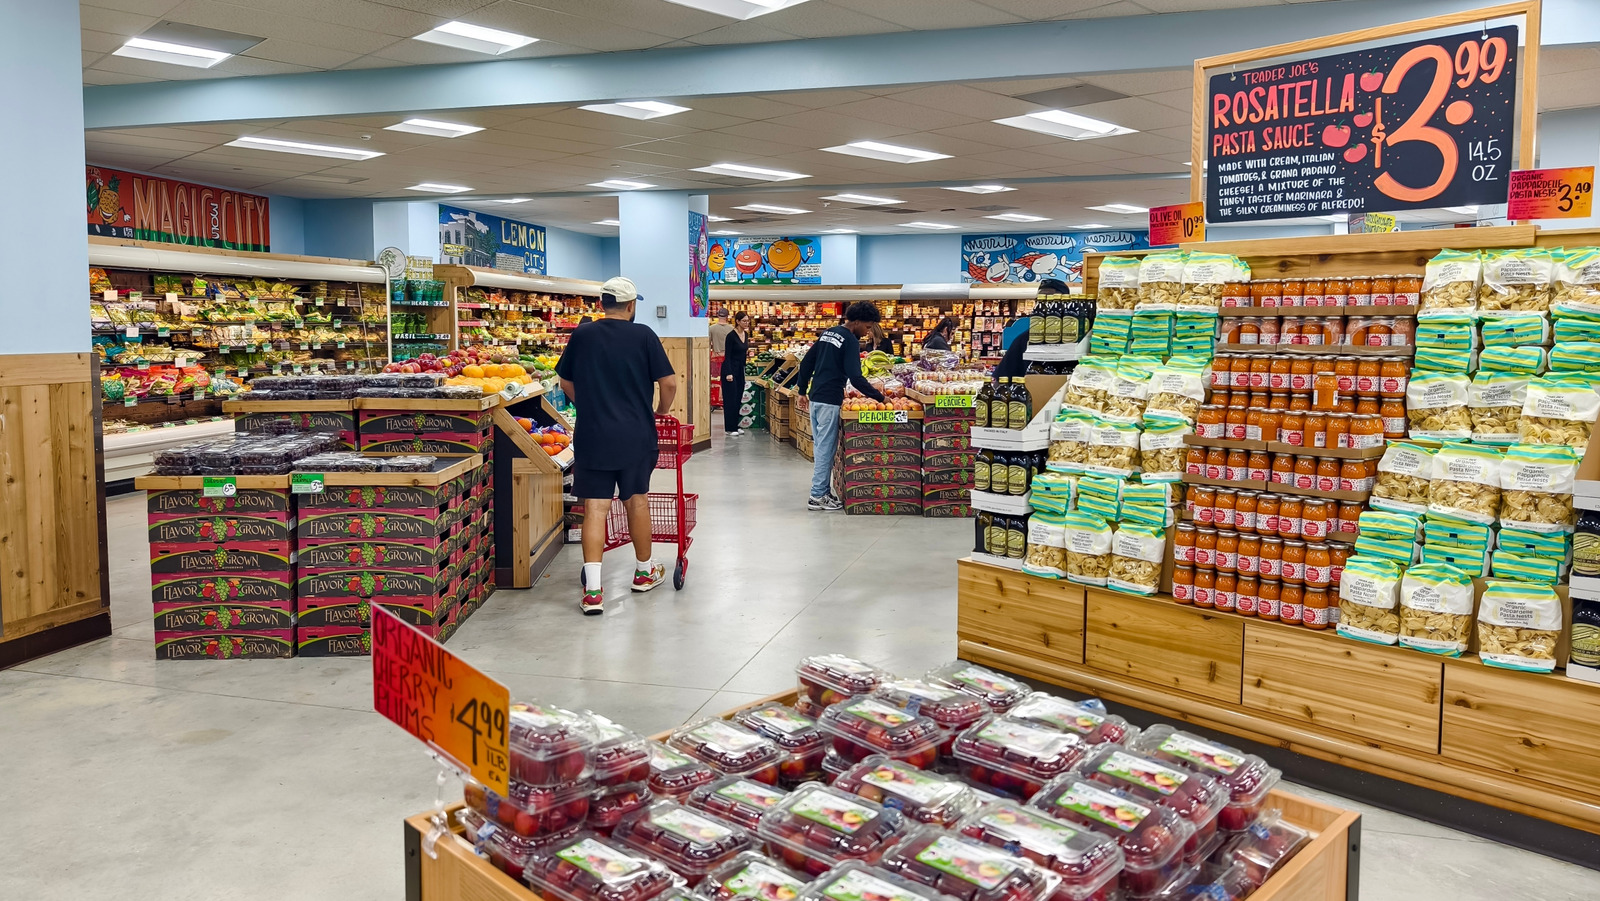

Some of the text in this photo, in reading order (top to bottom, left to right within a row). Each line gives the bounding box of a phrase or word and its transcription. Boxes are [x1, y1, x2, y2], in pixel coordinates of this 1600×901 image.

[1242, 62, 1319, 86] TRADER JOE'S
[1213, 72, 1355, 129] ROSATELLA
[1213, 122, 1315, 157] PASTA SAUCE
[1468, 139, 1502, 161] 14.5
[1218, 152, 1334, 172] MADE WITH CREAM, ITALIAN
[1270, 169, 1298, 180] GRANA
[1301, 165, 1336, 176] PADANO
[1472, 164, 1498, 181] OZ
[1218, 176, 1346, 197] CHEESE! A MIXTURE OF THE
[1510, 189, 1557, 199] PASTA NESTS
[1219, 188, 1343, 206] TANGY TASTE OF MARINARA &
[132, 176, 268, 252] MAGIC CITY
[1219, 198, 1365, 217] THE SILKY CREAMINESS OF ALFREDO!
[1150, 210, 1182, 222] OLIVE OIL
[501, 220, 545, 252] LEMON
[964, 234, 1017, 261] merrily
[1024, 235, 1077, 254] merrily
[1084, 232, 1140, 253] merrily
[524, 251, 544, 270] CITY
[938, 398, 966, 407] PEACHES
[311, 417, 344, 428] GROWN
[386, 418, 453, 429] FLAVOR GROWN
[860, 412, 894, 421] PEACHES
[422, 444, 450, 452] GROWN
[160, 495, 275, 510] FLAVOR GROWN
[310, 491, 423, 505] FLAVOR GROWN
[160, 524, 276, 540] FLAVOR GROWN
[310, 521, 423, 535] FLAVOR GROWN
[181, 555, 260, 570] FLAVOR GROWN
[310, 550, 423, 564] FLAVOR GROWN
[163, 585, 277, 600] FLAVOR GROWN
[310, 578, 422, 593] FLAVOR GROWN
[165, 613, 280, 628] FLAVOR GROWN
[325, 608, 356, 622] FLAVOR
[167, 642, 280, 658] FLAVOR GROWN
[328, 639, 360, 653] FLAVOR
[374, 610, 454, 690] ORGANIC
[374, 649, 438, 714] CHERRY
[375, 684, 436, 742] PLUMS
[488, 770, 503, 784] EA
